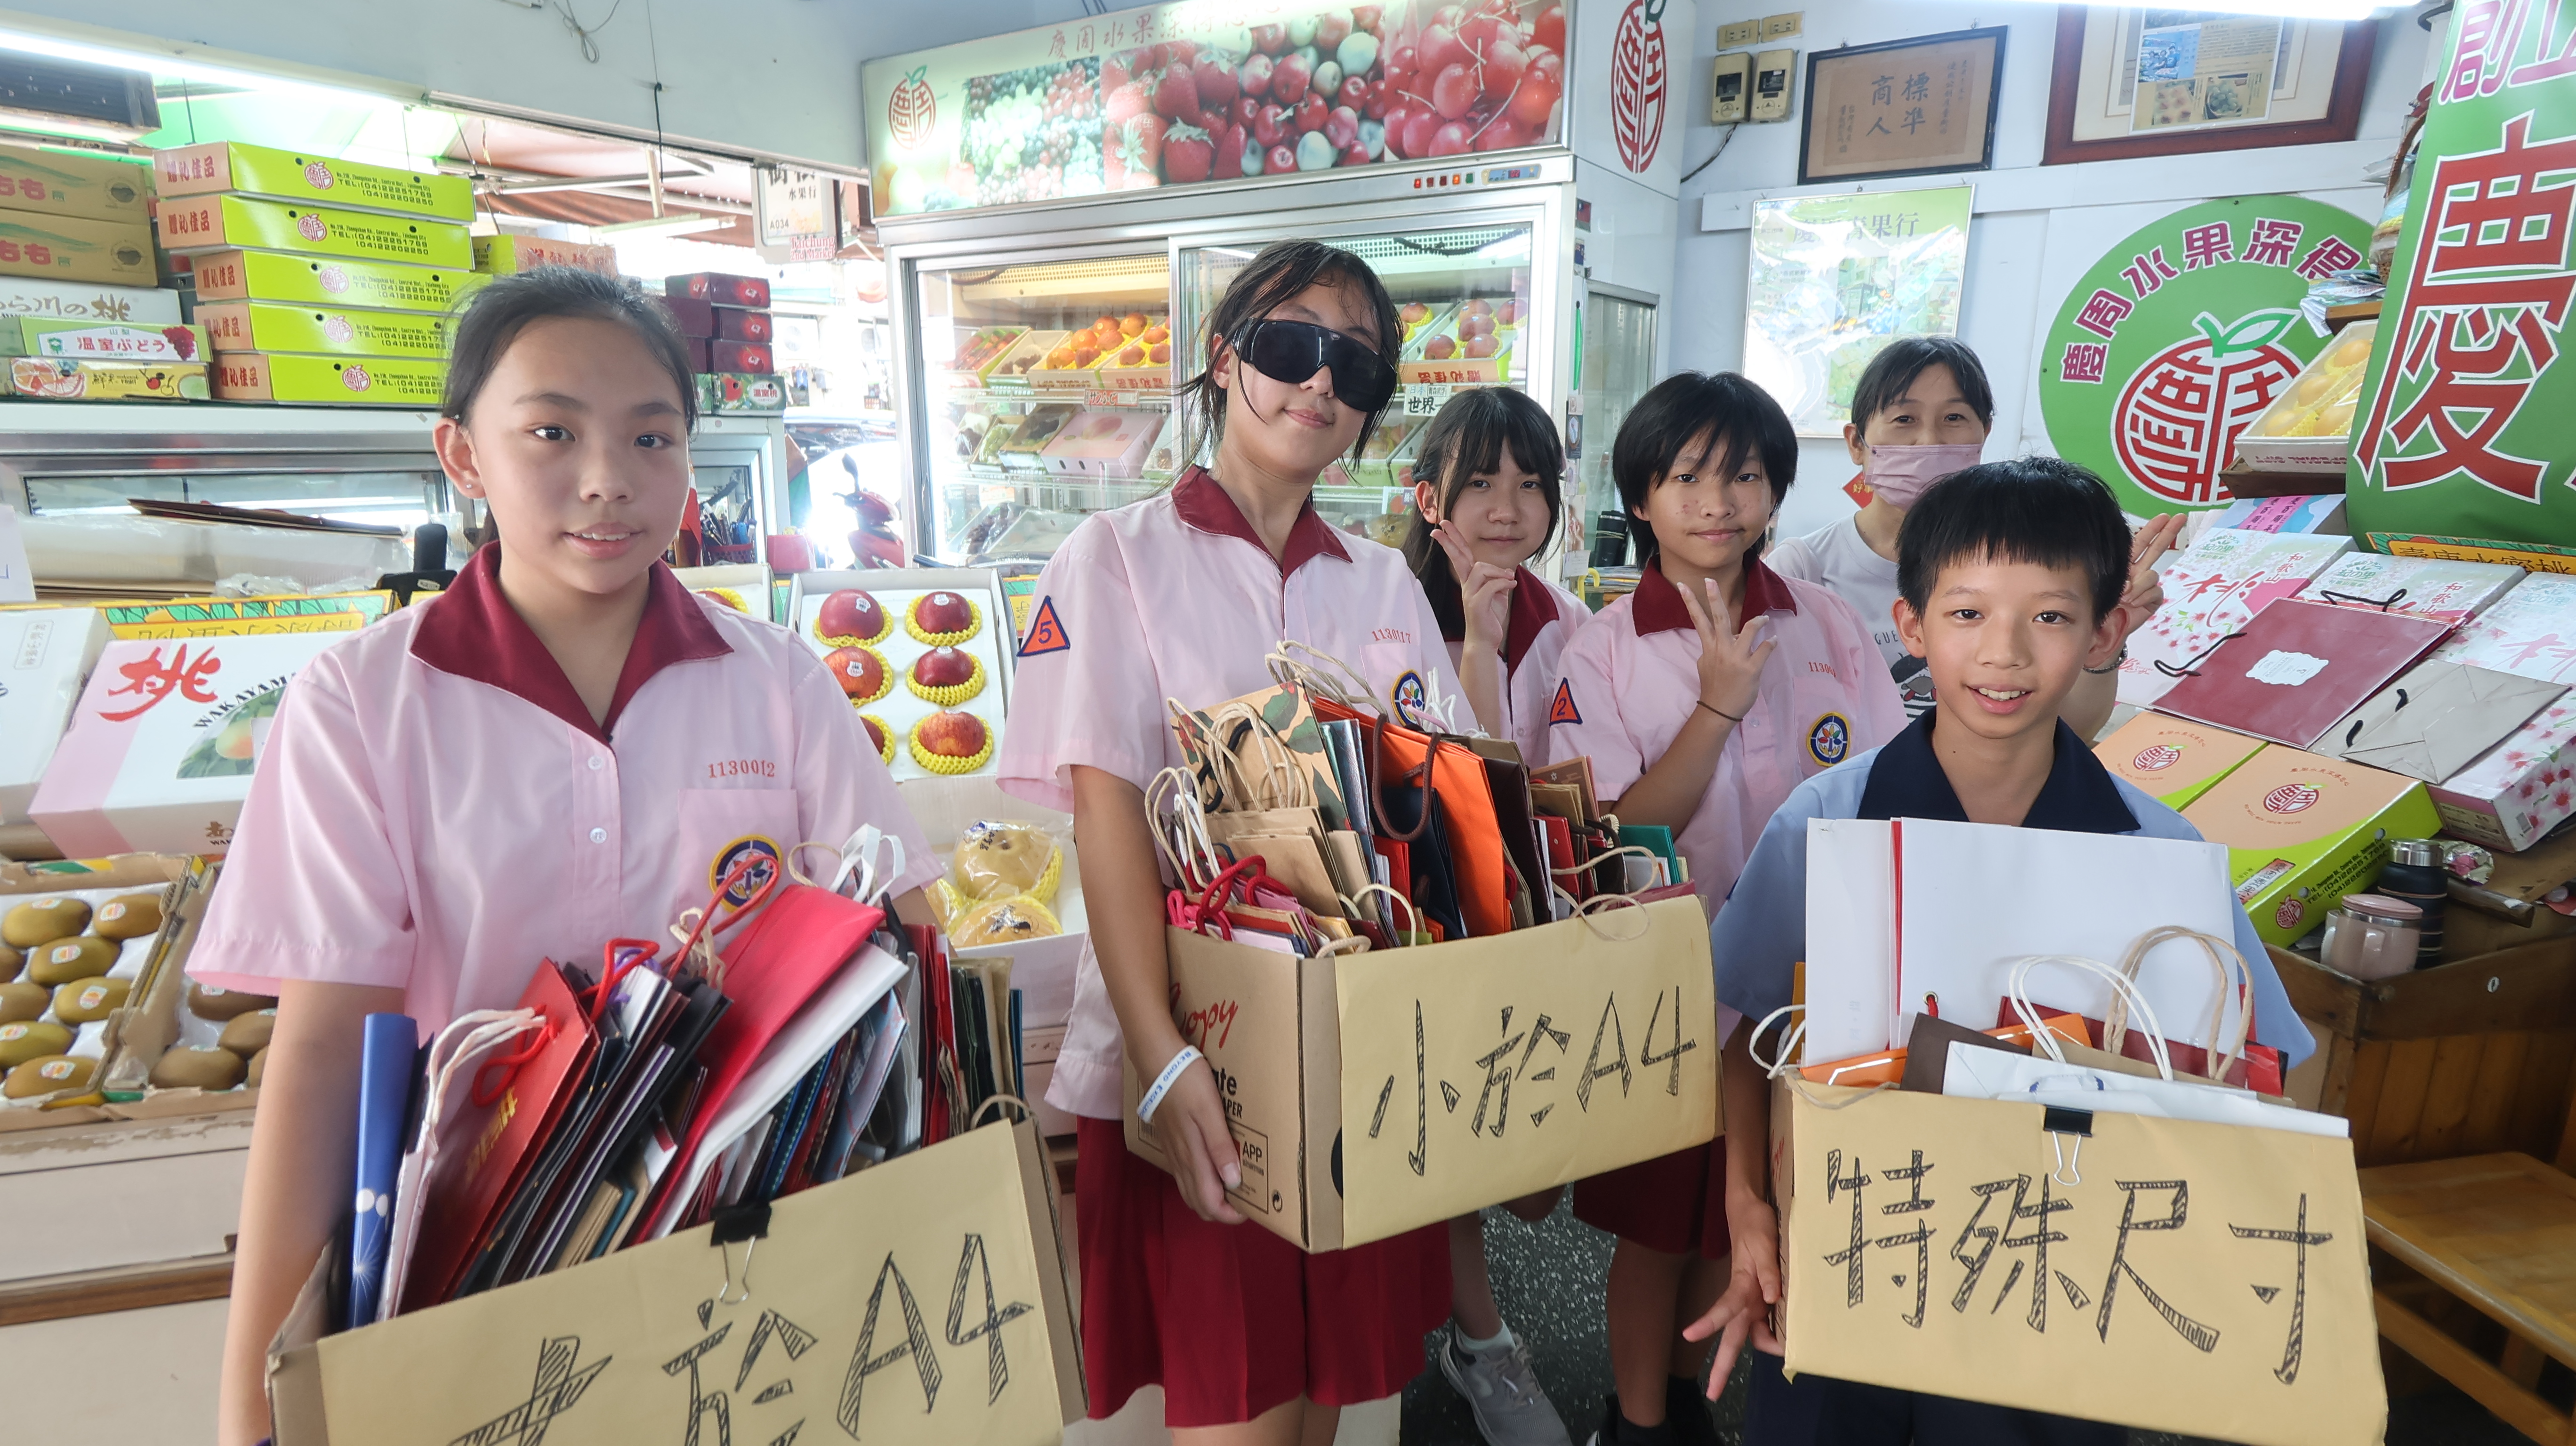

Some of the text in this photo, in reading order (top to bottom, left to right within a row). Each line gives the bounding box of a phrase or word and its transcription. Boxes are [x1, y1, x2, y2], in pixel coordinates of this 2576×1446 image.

[1866, 75, 1895, 137] 商人
[789, 185, 816, 201] 水果行
[770, 219, 789, 230] A034
[790, 236, 835, 249] Taichung
[791, 249, 836, 261] 2nd Market
[76, 336, 166, 353] 温室ぶどう
[1410, 385, 1426, 396] 日本
[2264, 552, 2304, 585] 和歌山
[2338, 569, 2376, 579] 紀の里
[1038, 620, 1054, 644] 5
[98, 643, 222, 723] 桃
[1557, 697, 1567, 715] 2
[708, 759, 776, 779] 1130012
[1368, 985, 1697, 1177] 小於A4
[1243, 1141, 1263, 1163] APP
[1822, 1149, 2334, 1385] 特殊尺寸
